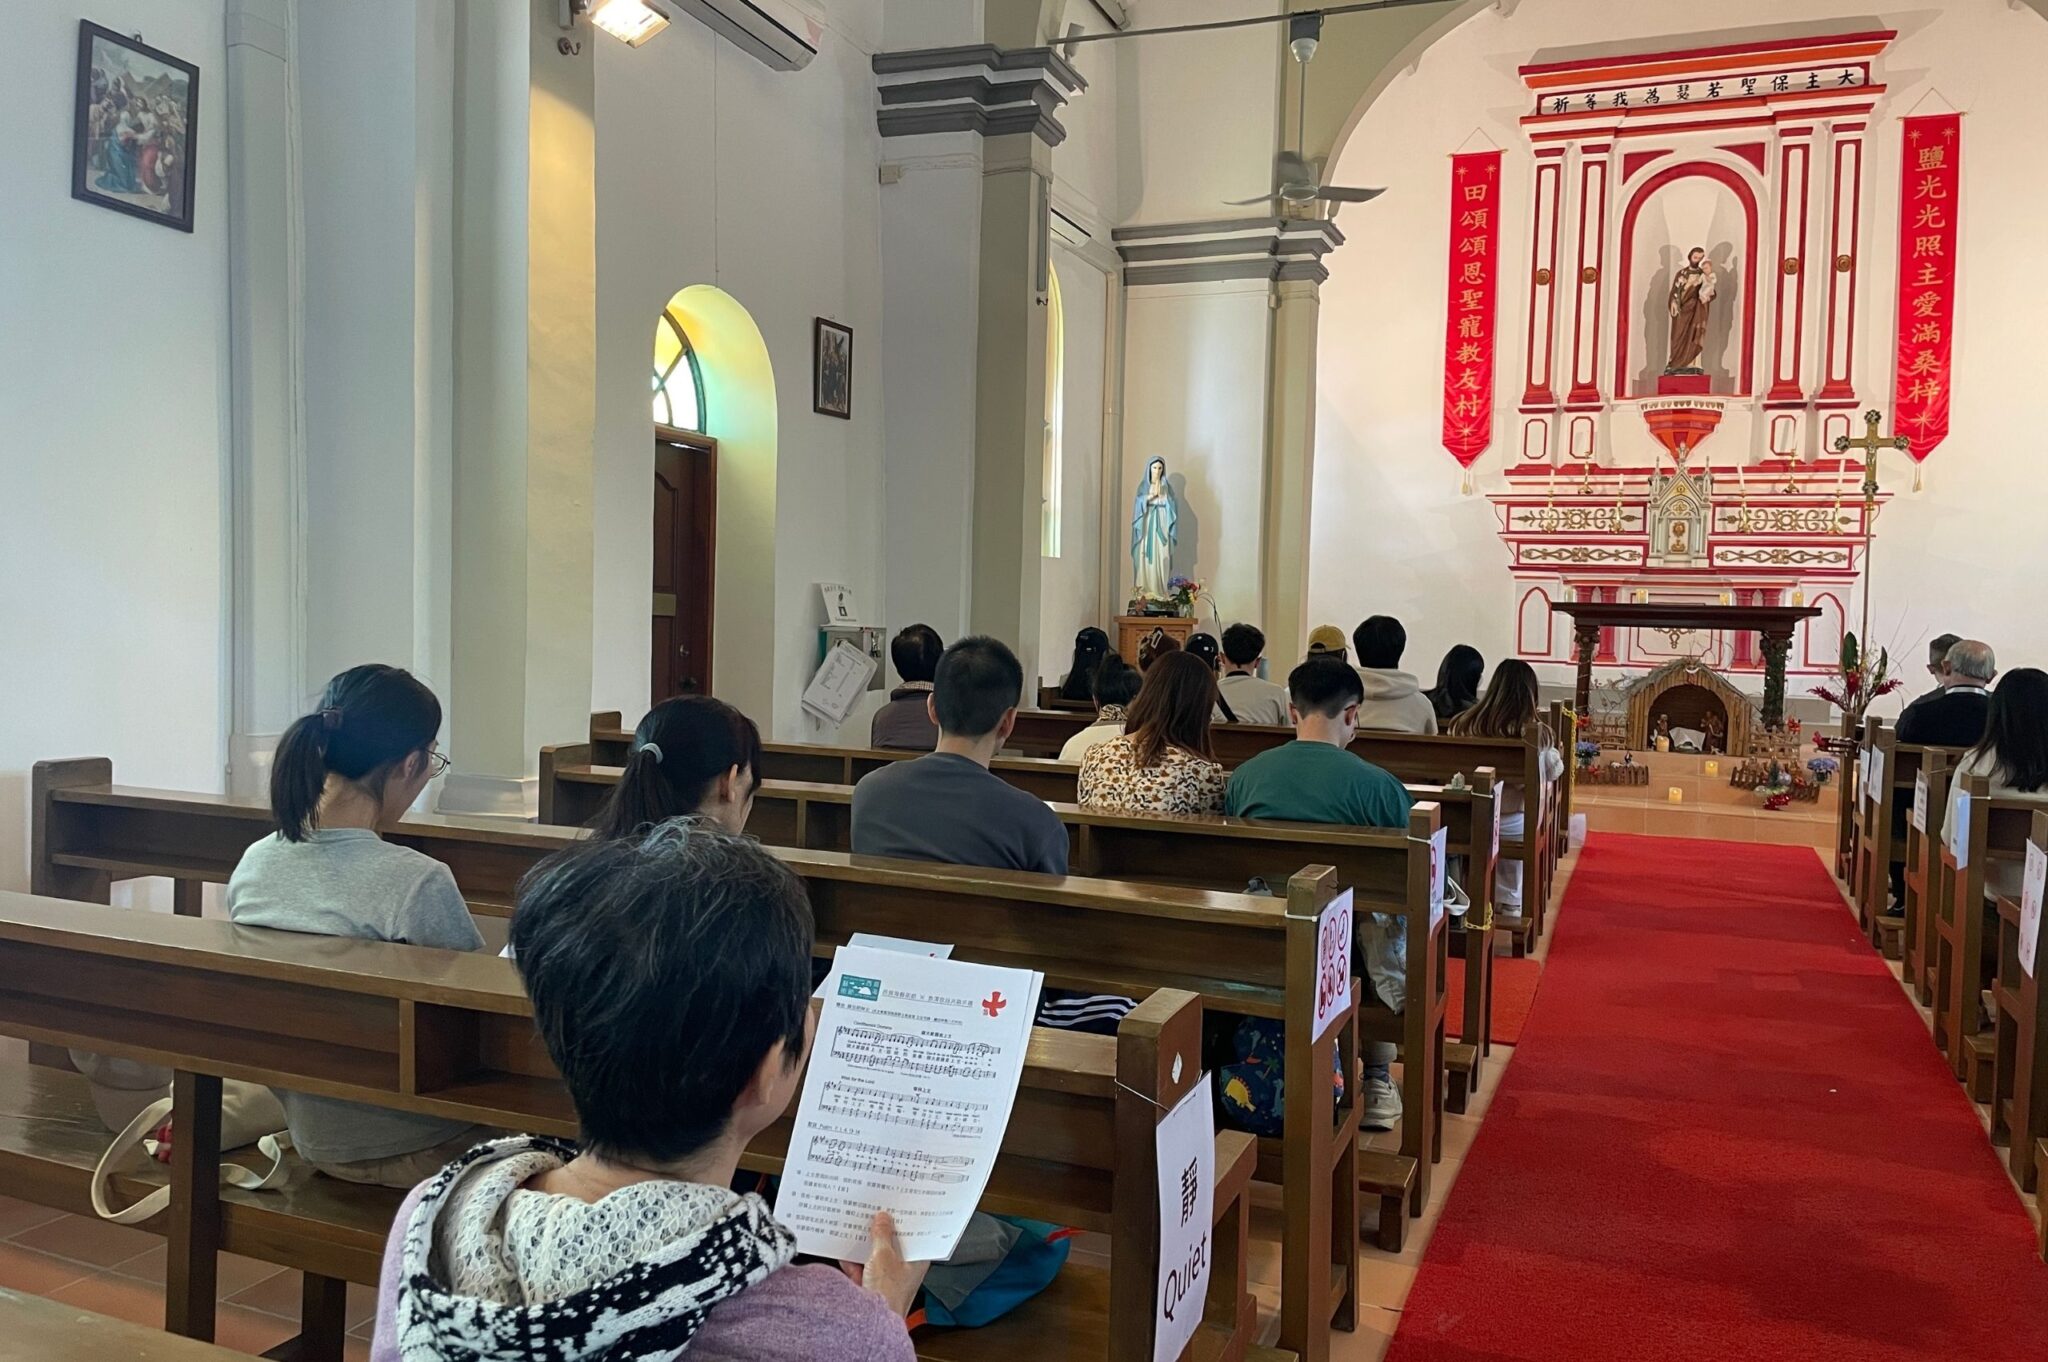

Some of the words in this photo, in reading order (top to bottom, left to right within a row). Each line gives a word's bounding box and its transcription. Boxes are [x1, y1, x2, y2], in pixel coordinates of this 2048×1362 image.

[1454, 183, 1490, 418] 田頌頌恩聖寵教友村
[1181, 1156, 1198, 1228] 靜
[1164, 1230, 1207, 1322] Quiet
